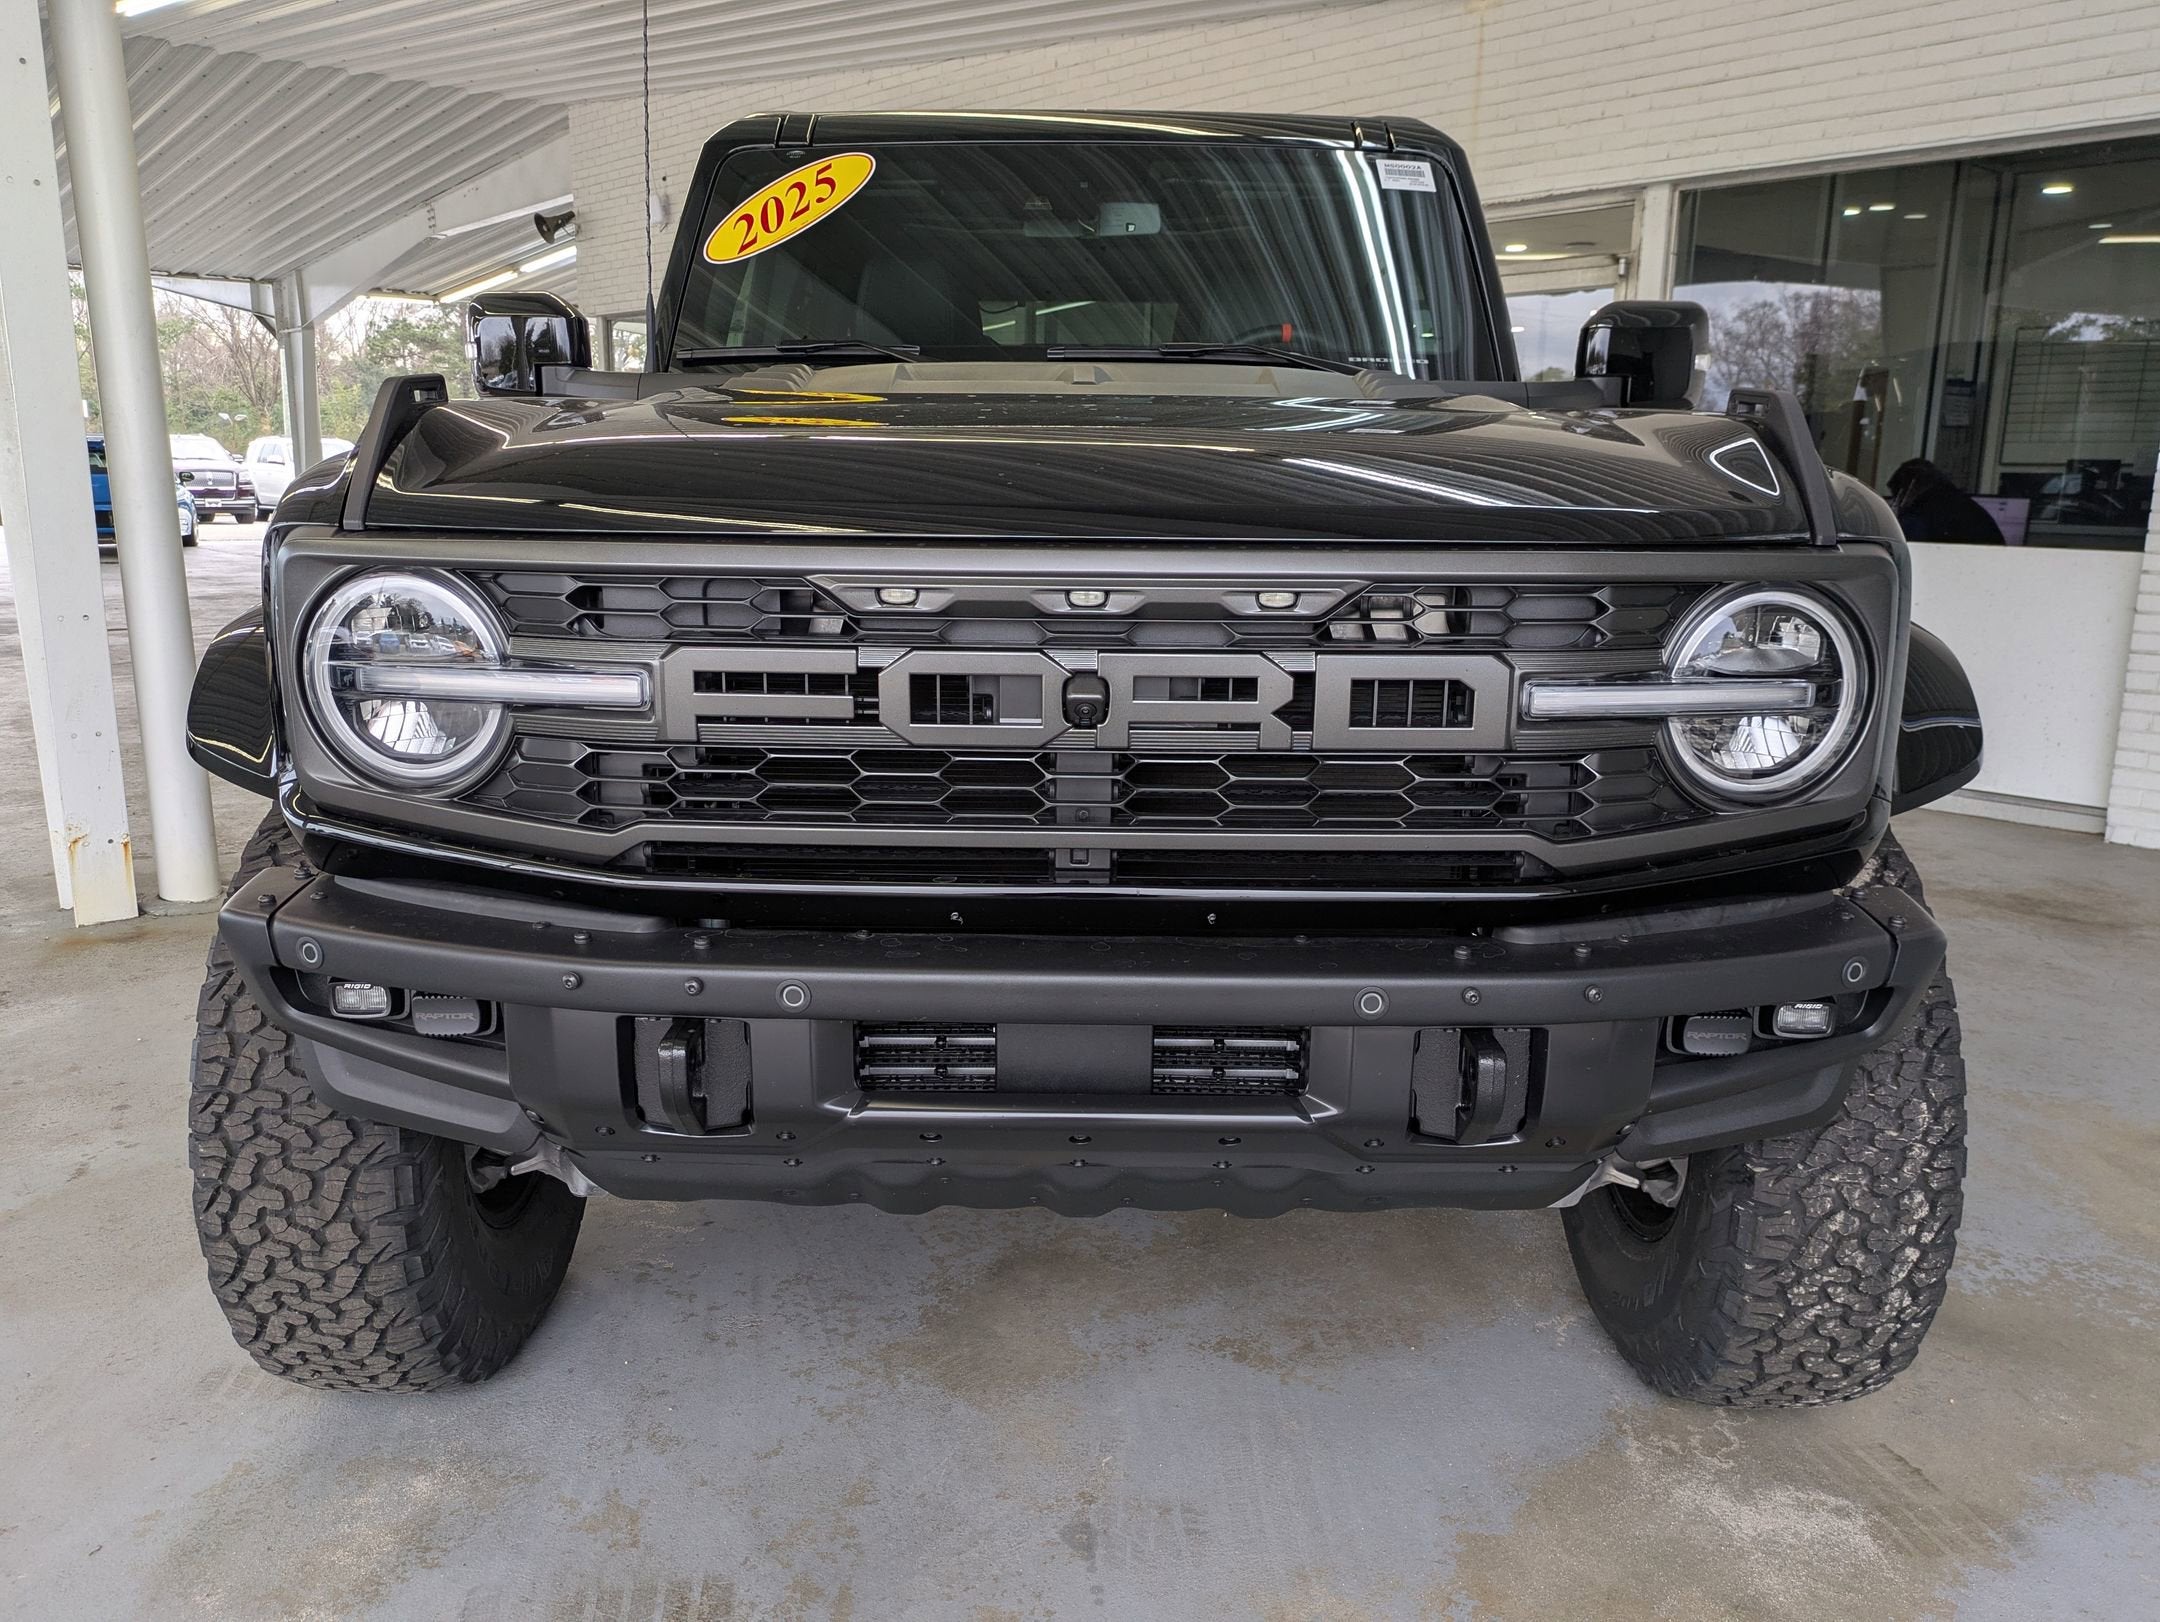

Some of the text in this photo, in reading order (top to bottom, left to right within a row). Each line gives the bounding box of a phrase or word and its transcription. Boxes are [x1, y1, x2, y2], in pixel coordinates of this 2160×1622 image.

[733, 163, 836, 255] 2025
[664, 646, 1511, 750] FORD
[415, 1012, 477, 1021] RAPTOR
[1686, 1032, 1747, 1041] RAPTOR
